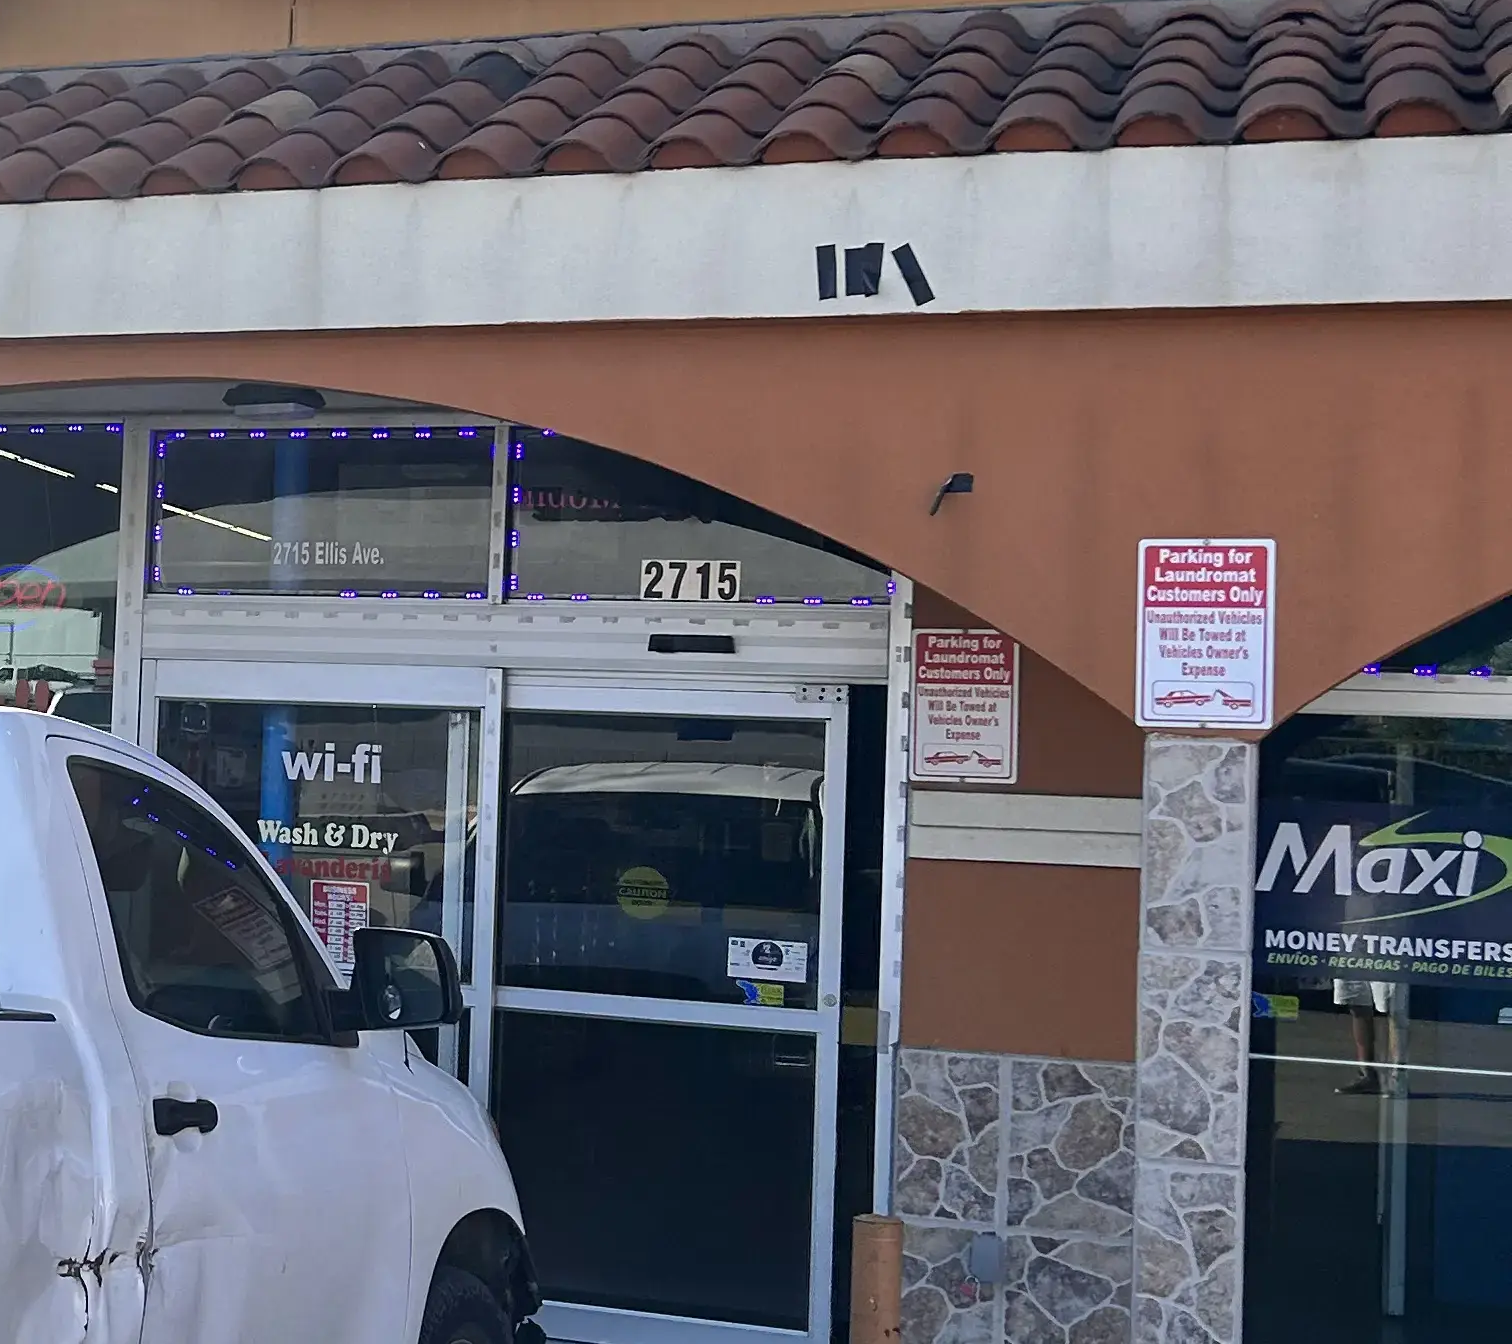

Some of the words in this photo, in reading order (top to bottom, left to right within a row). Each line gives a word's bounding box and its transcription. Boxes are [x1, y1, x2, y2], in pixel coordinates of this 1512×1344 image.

[273, 541, 310, 565] 2715
[315, 541, 347, 565] Ellis
[352, 541, 384, 565] Ave.
[1159, 548, 1224, 567] Parking
[1227, 549, 1253, 564] for
[643, 561, 737, 600] 2715
[1154, 566, 1256, 582] Laundromat
[1147, 585, 1226, 602] Customers
[1229, 585, 1264, 606] Only
[1147, 610, 1215, 624] Unauthorized
[1218, 610, 1262, 625] Vehicles
[1158, 628, 1179, 641] Will
[1181, 628, 1196, 641] Be
[1198, 628, 1232, 641] Towed
[1234, 629, 1247, 642] at
[928, 636, 979, 651] Parking
[982, 637, 1003, 649] for
[924, 651, 1005, 664] Laundromat
[1158, 645, 1203, 659] Vehicles
[1205, 645, 1249, 660] Owner's
[918, 665, 981, 680] Customers
[983, 666, 1011, 683] Only
[1181, 662, 1226, 679] Expense
[918, 687, 973, 697] Unauthorized
[974, 687, 1010, 698] Vehicles
[928, 700, 944, 711] Will
[946, 700, 957, 712] Be
[959, 700, 986, 712] Towed
[988, 702, 997, 712] at
[928, 715, 963, 726] Vehicles
[964, 715, 999, 727] Owner's
[945, 728, 981, 742] Expense
[281, 742, 382, 784] wi-fi
[257, 819, 318, 846] Wash
[324, 822, 345, 847] &
[350, 824, 399, 855] Dry
[1255, 822, 1483, 897] Maxi
[618, 887, 667, 899] CAUTION
[1265, 929, 1358, 953] MONEY
[1362, 934, 1512, 963] TRANSFERS
[1267, 951, 1318, 966] ENVÍOS
[1328, 956, 1400, 971] RECARGAS
[1411, 961, 1448, 974] PAGO
[1451, 963, 1471, 975] DE
[1473, 965, 1512, 978] BILES
